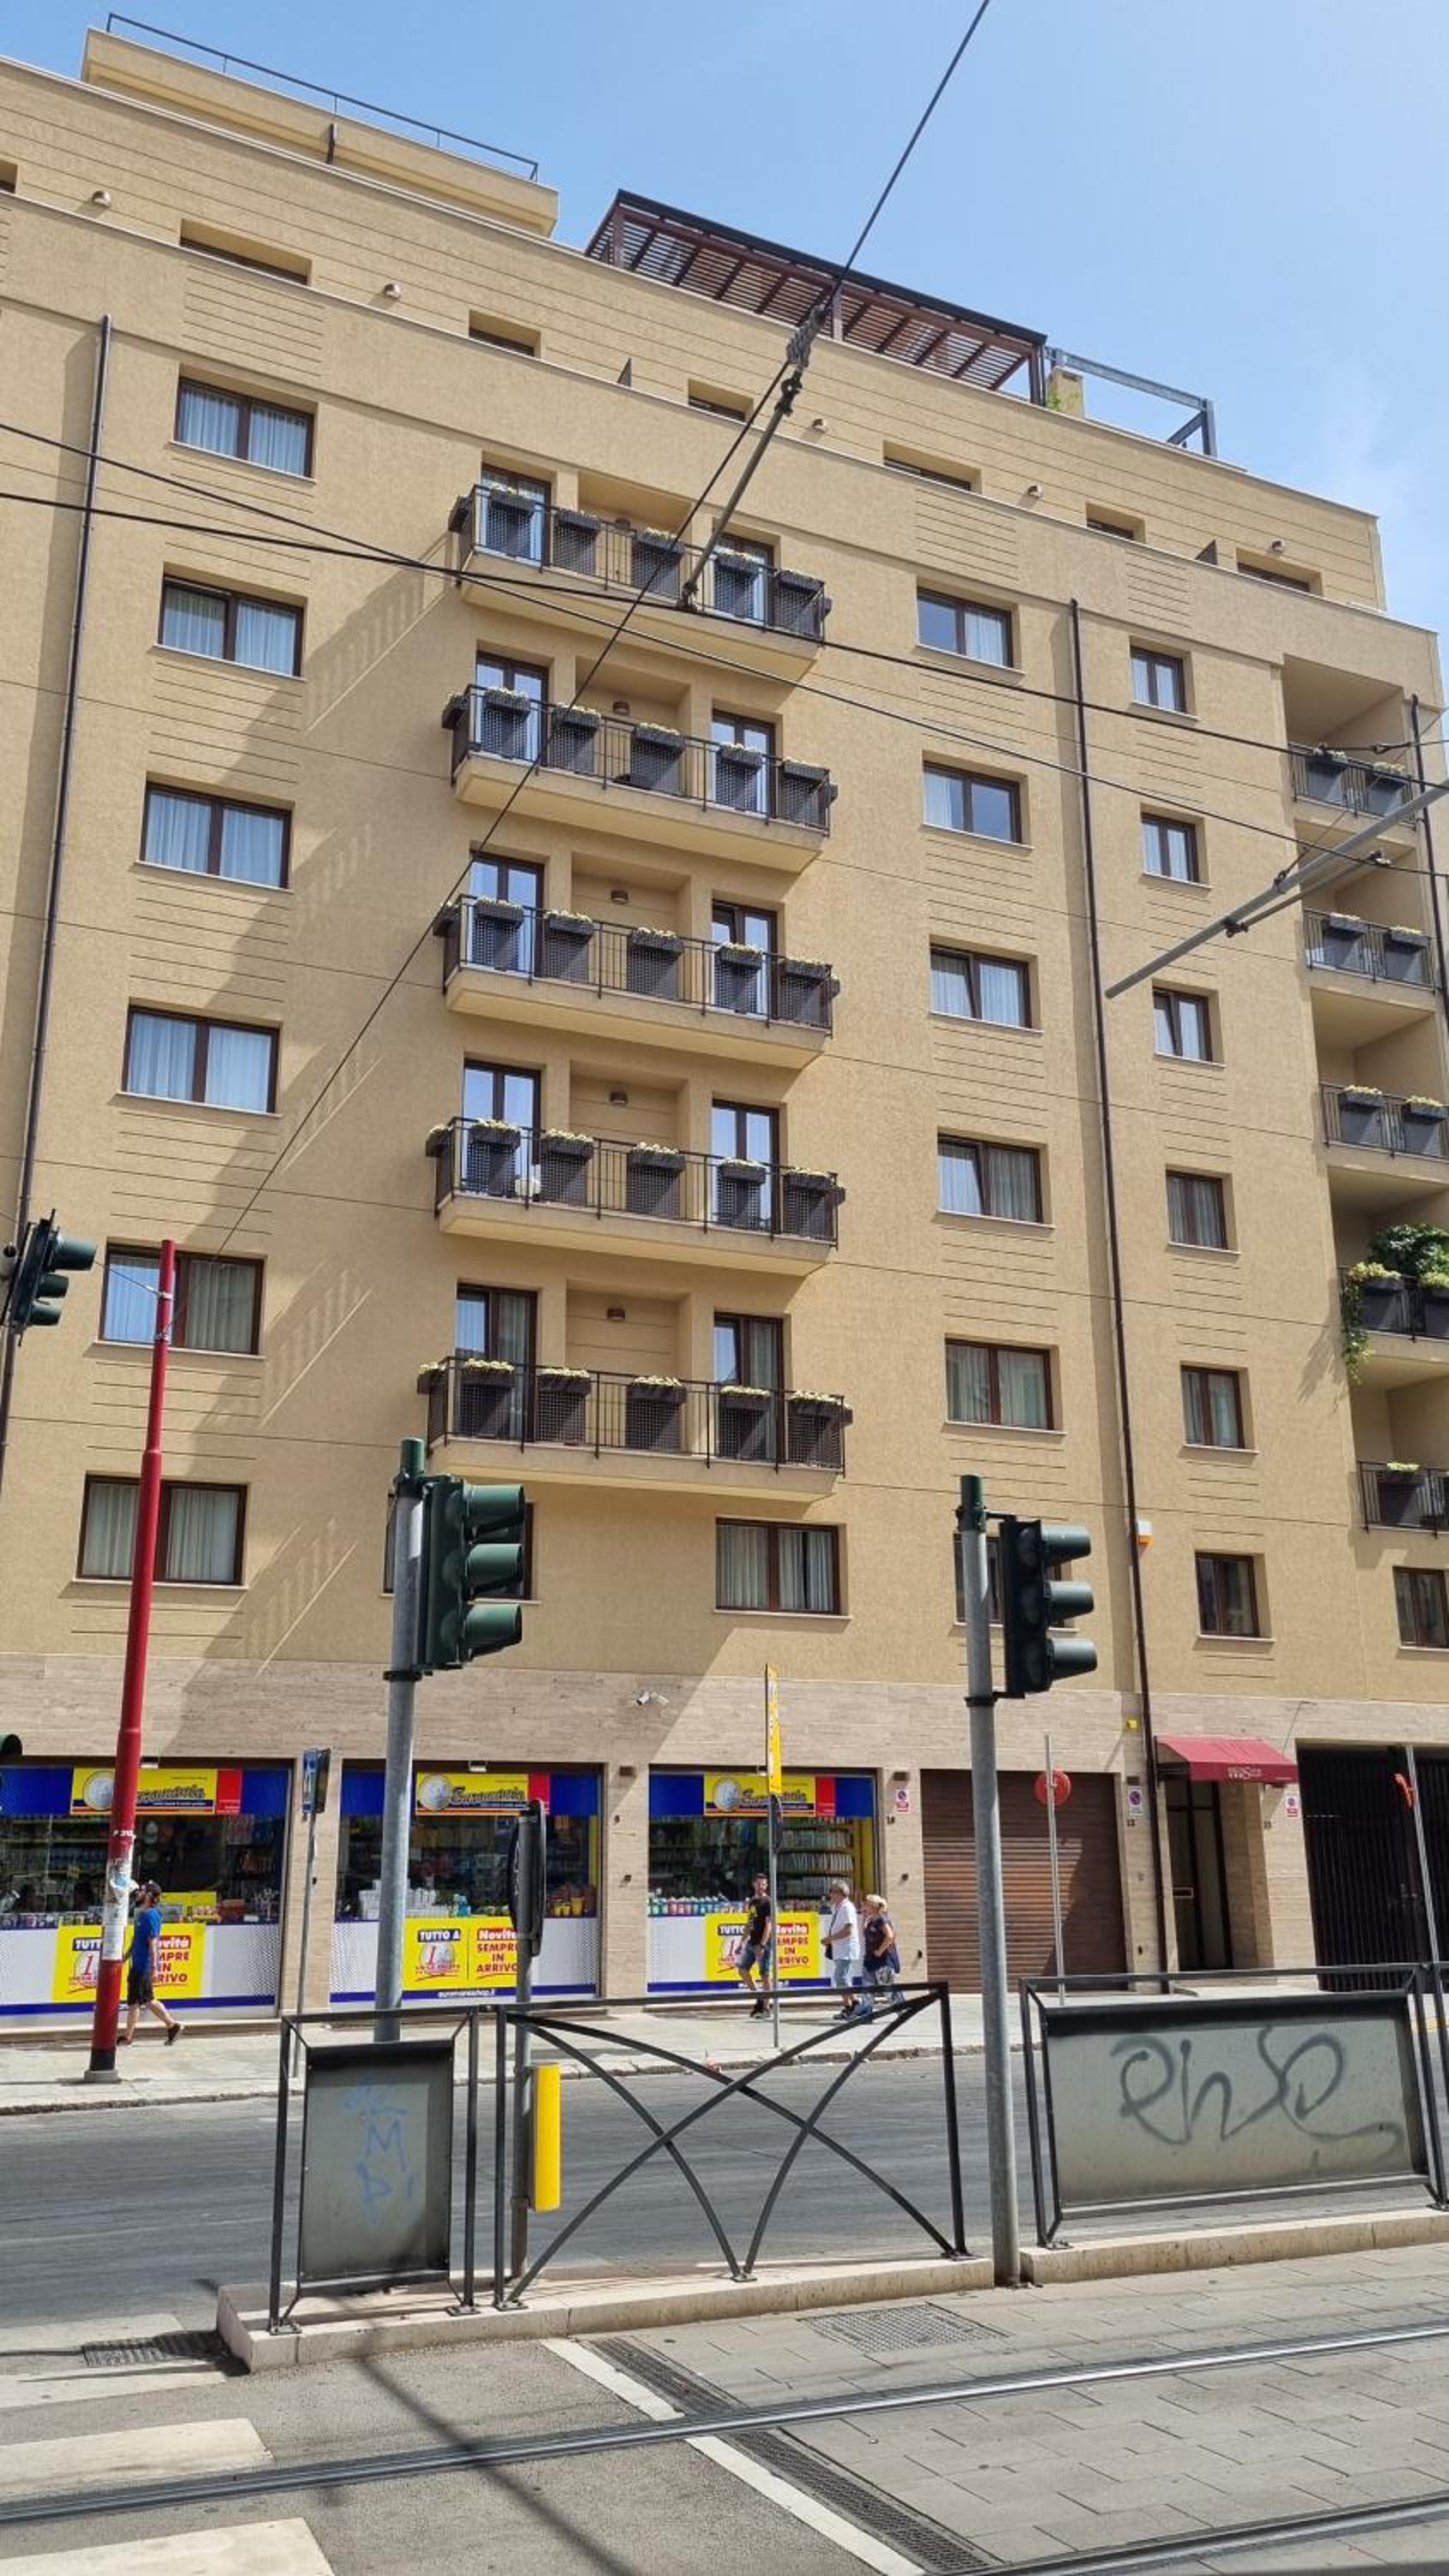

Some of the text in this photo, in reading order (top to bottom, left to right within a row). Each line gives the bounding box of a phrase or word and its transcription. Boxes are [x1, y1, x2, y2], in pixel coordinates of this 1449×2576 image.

[420, 1931, 451, 1941] TUTTO
[76, 1939, 101, 1949] TUTT
[477, 1943, 518, 1952] SEMPR
[492, 1953, 505, 1962] IN
